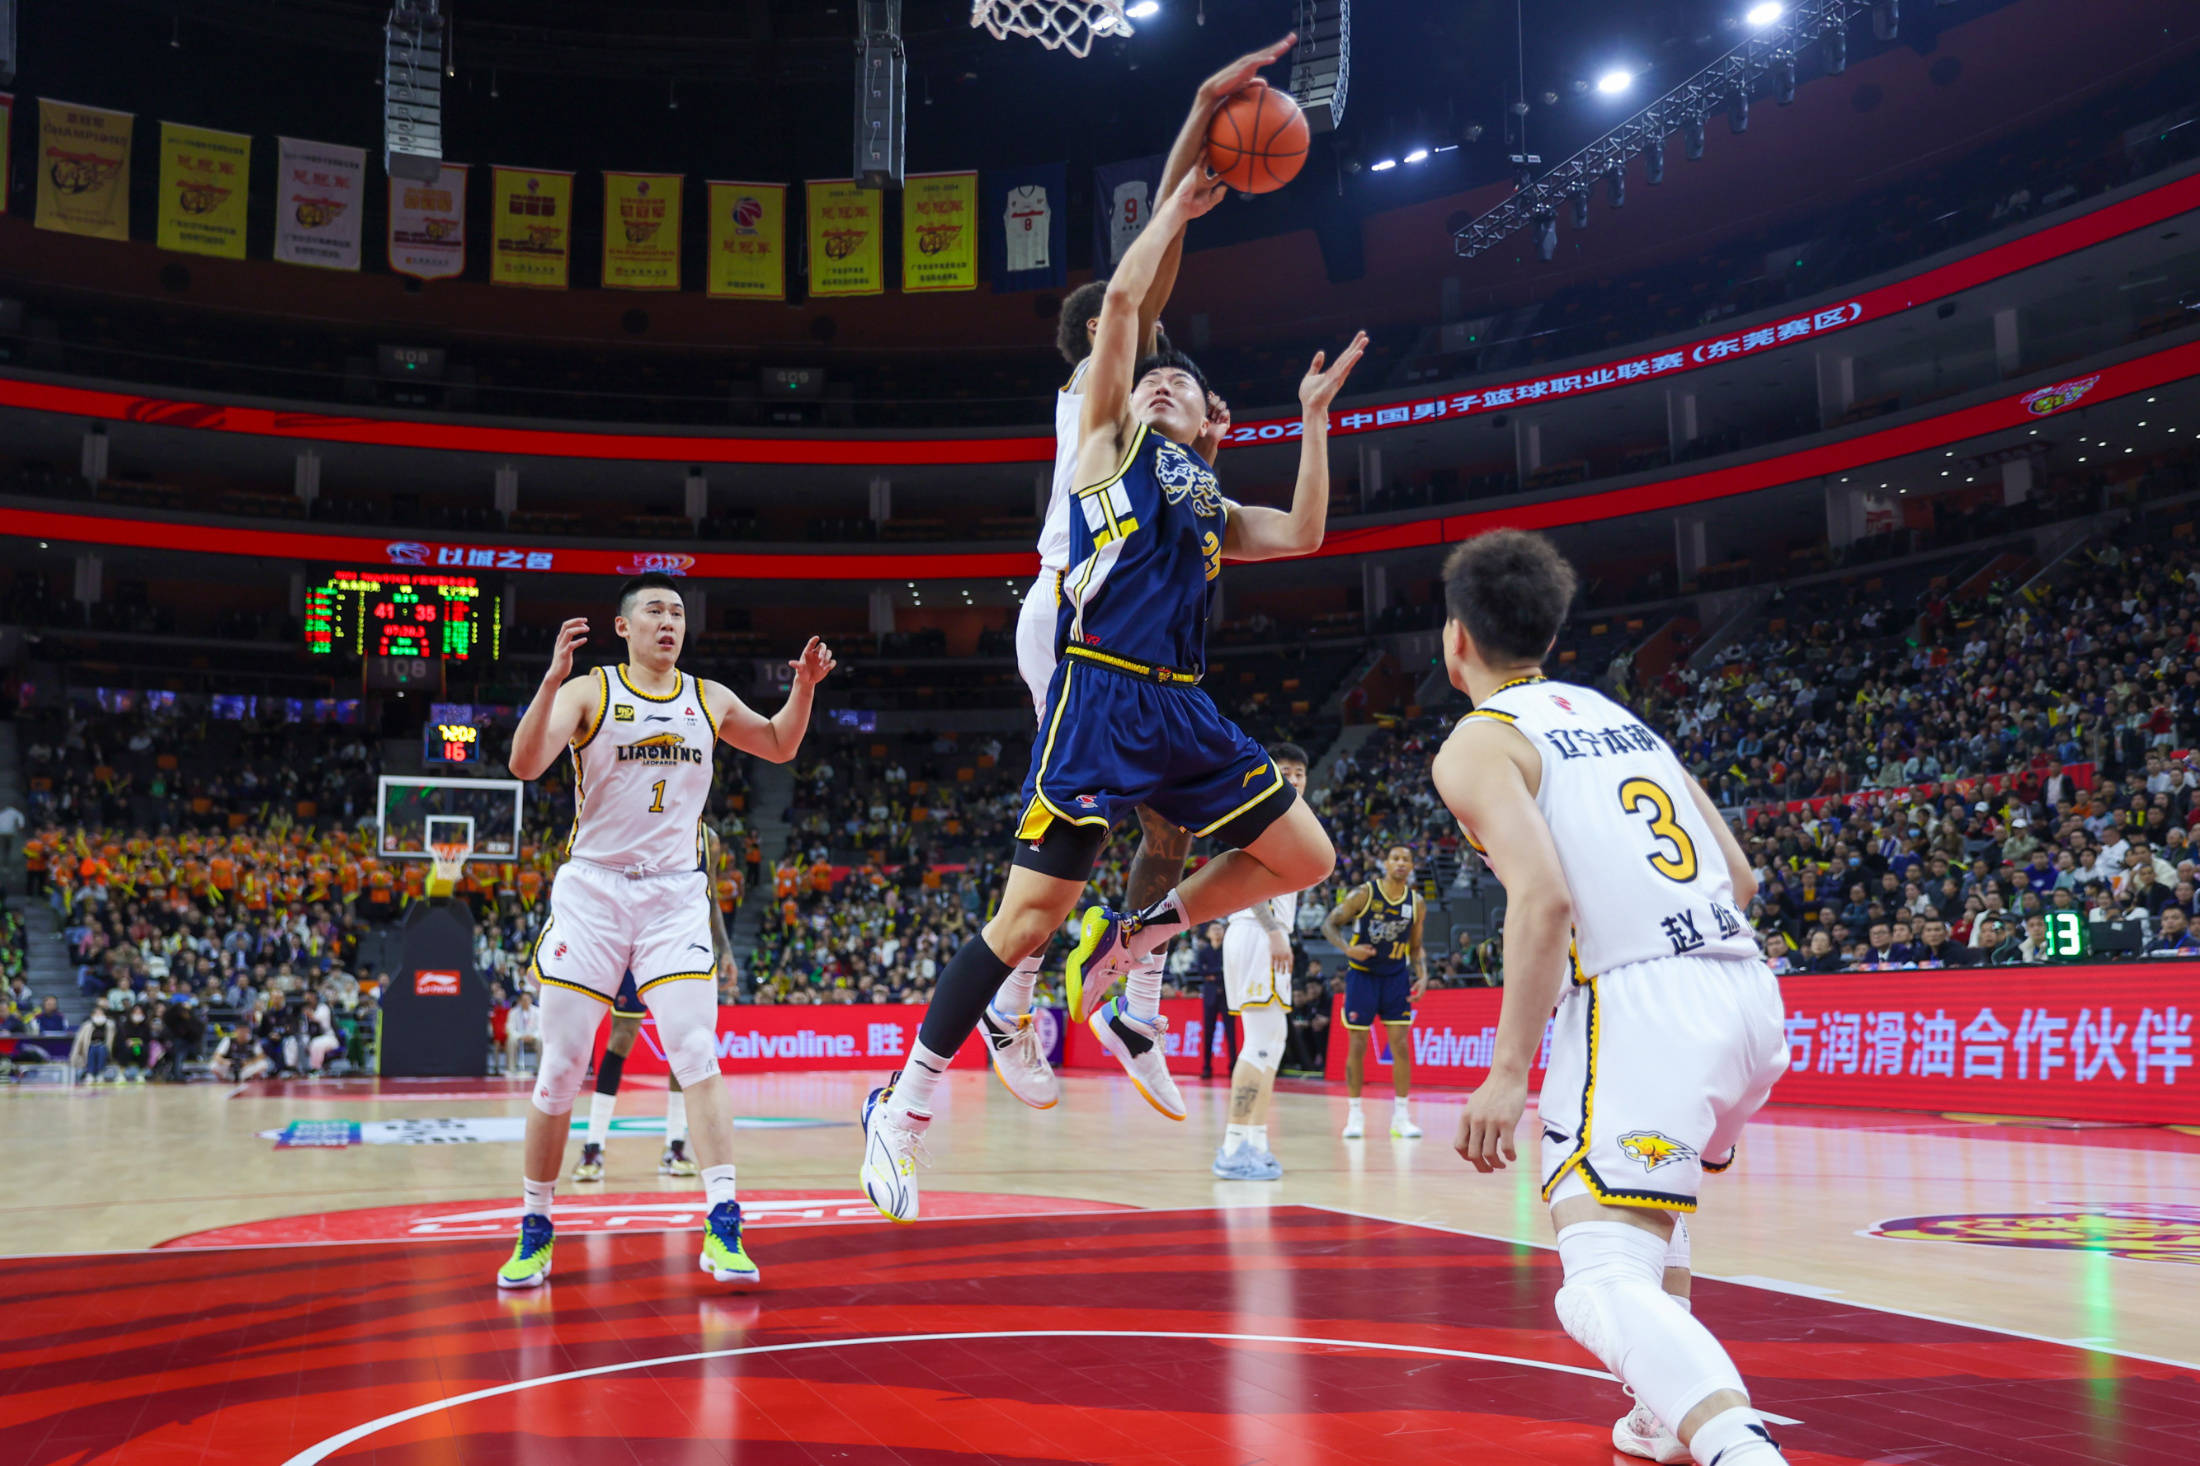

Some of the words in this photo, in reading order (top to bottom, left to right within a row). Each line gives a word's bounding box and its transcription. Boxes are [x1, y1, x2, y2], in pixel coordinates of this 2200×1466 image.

[1123, 197, 1138, 224] 9
[1223, 419, 1332, 442] -202
[437, 546, 553, 570] 以城之名
[374, 602, 395, 619] 41
[414, 604, 437, 622] 35
[444, 742, 467, 761] 16
[617, 745, 702, 764] LIAONING
[648, 779, 666, 813] 1
[1618, 776, 1699, 884] 3
[2045, 913, 2082, 956] 13
[1413, 1027, 1497, 1068] Valvoli
